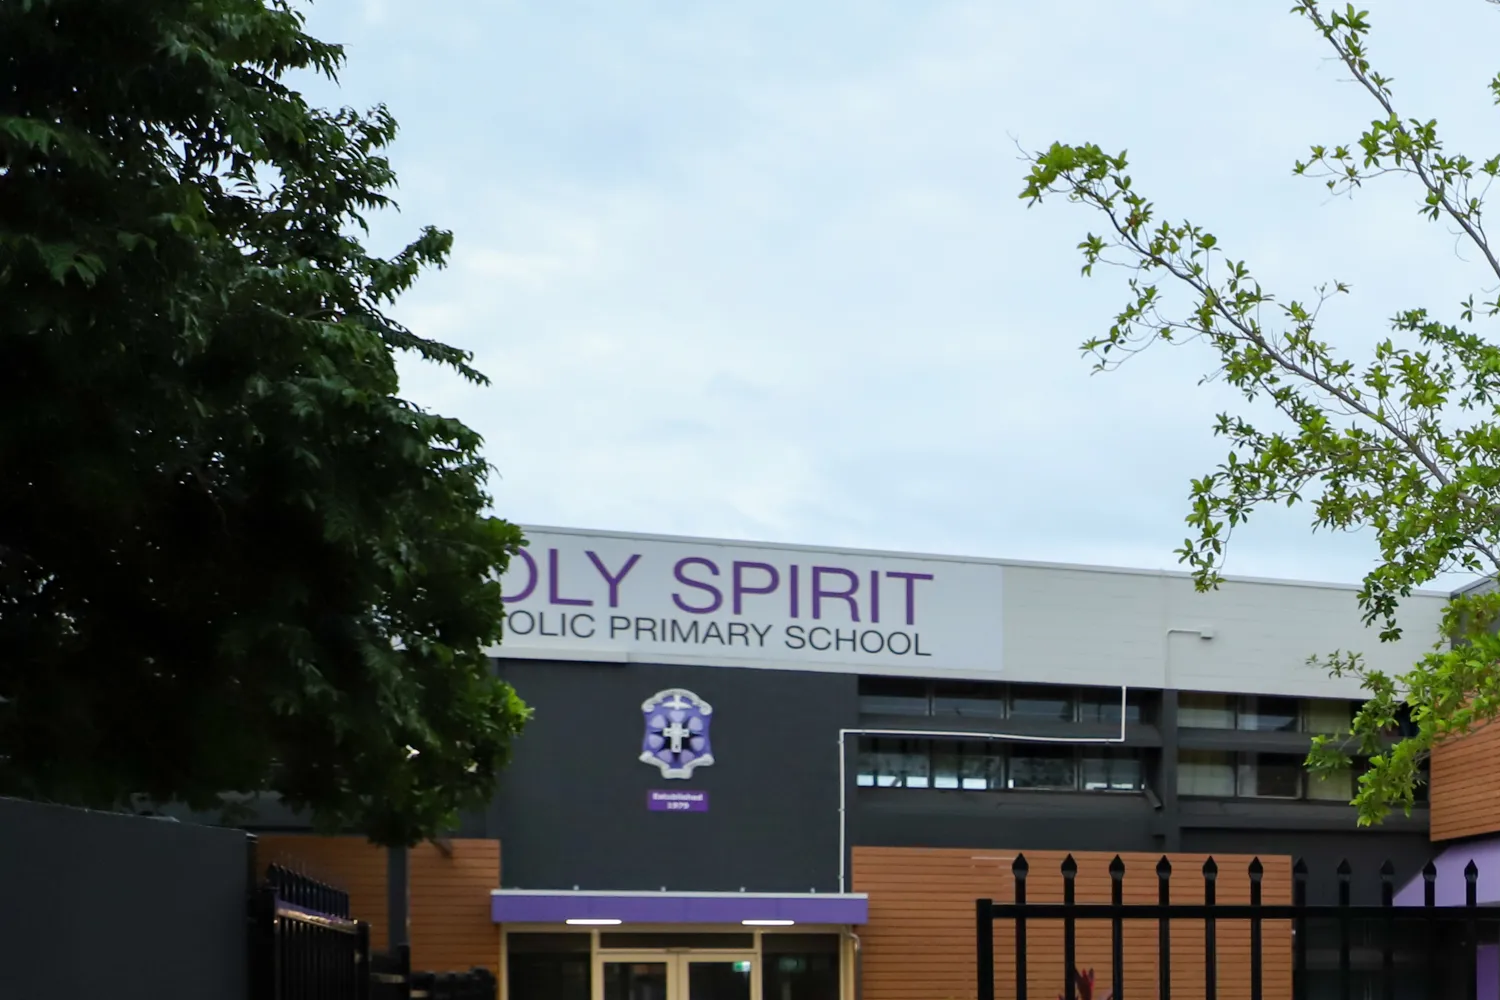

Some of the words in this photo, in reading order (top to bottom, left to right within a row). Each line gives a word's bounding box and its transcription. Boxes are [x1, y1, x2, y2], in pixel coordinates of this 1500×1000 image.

[501, 547, 642, 609] OLY
[671, 557, 935, 626] SPIRIT
[609, 615, 773, 649] PRIMARY
[784, 625, 933, 657] SCHOOL
